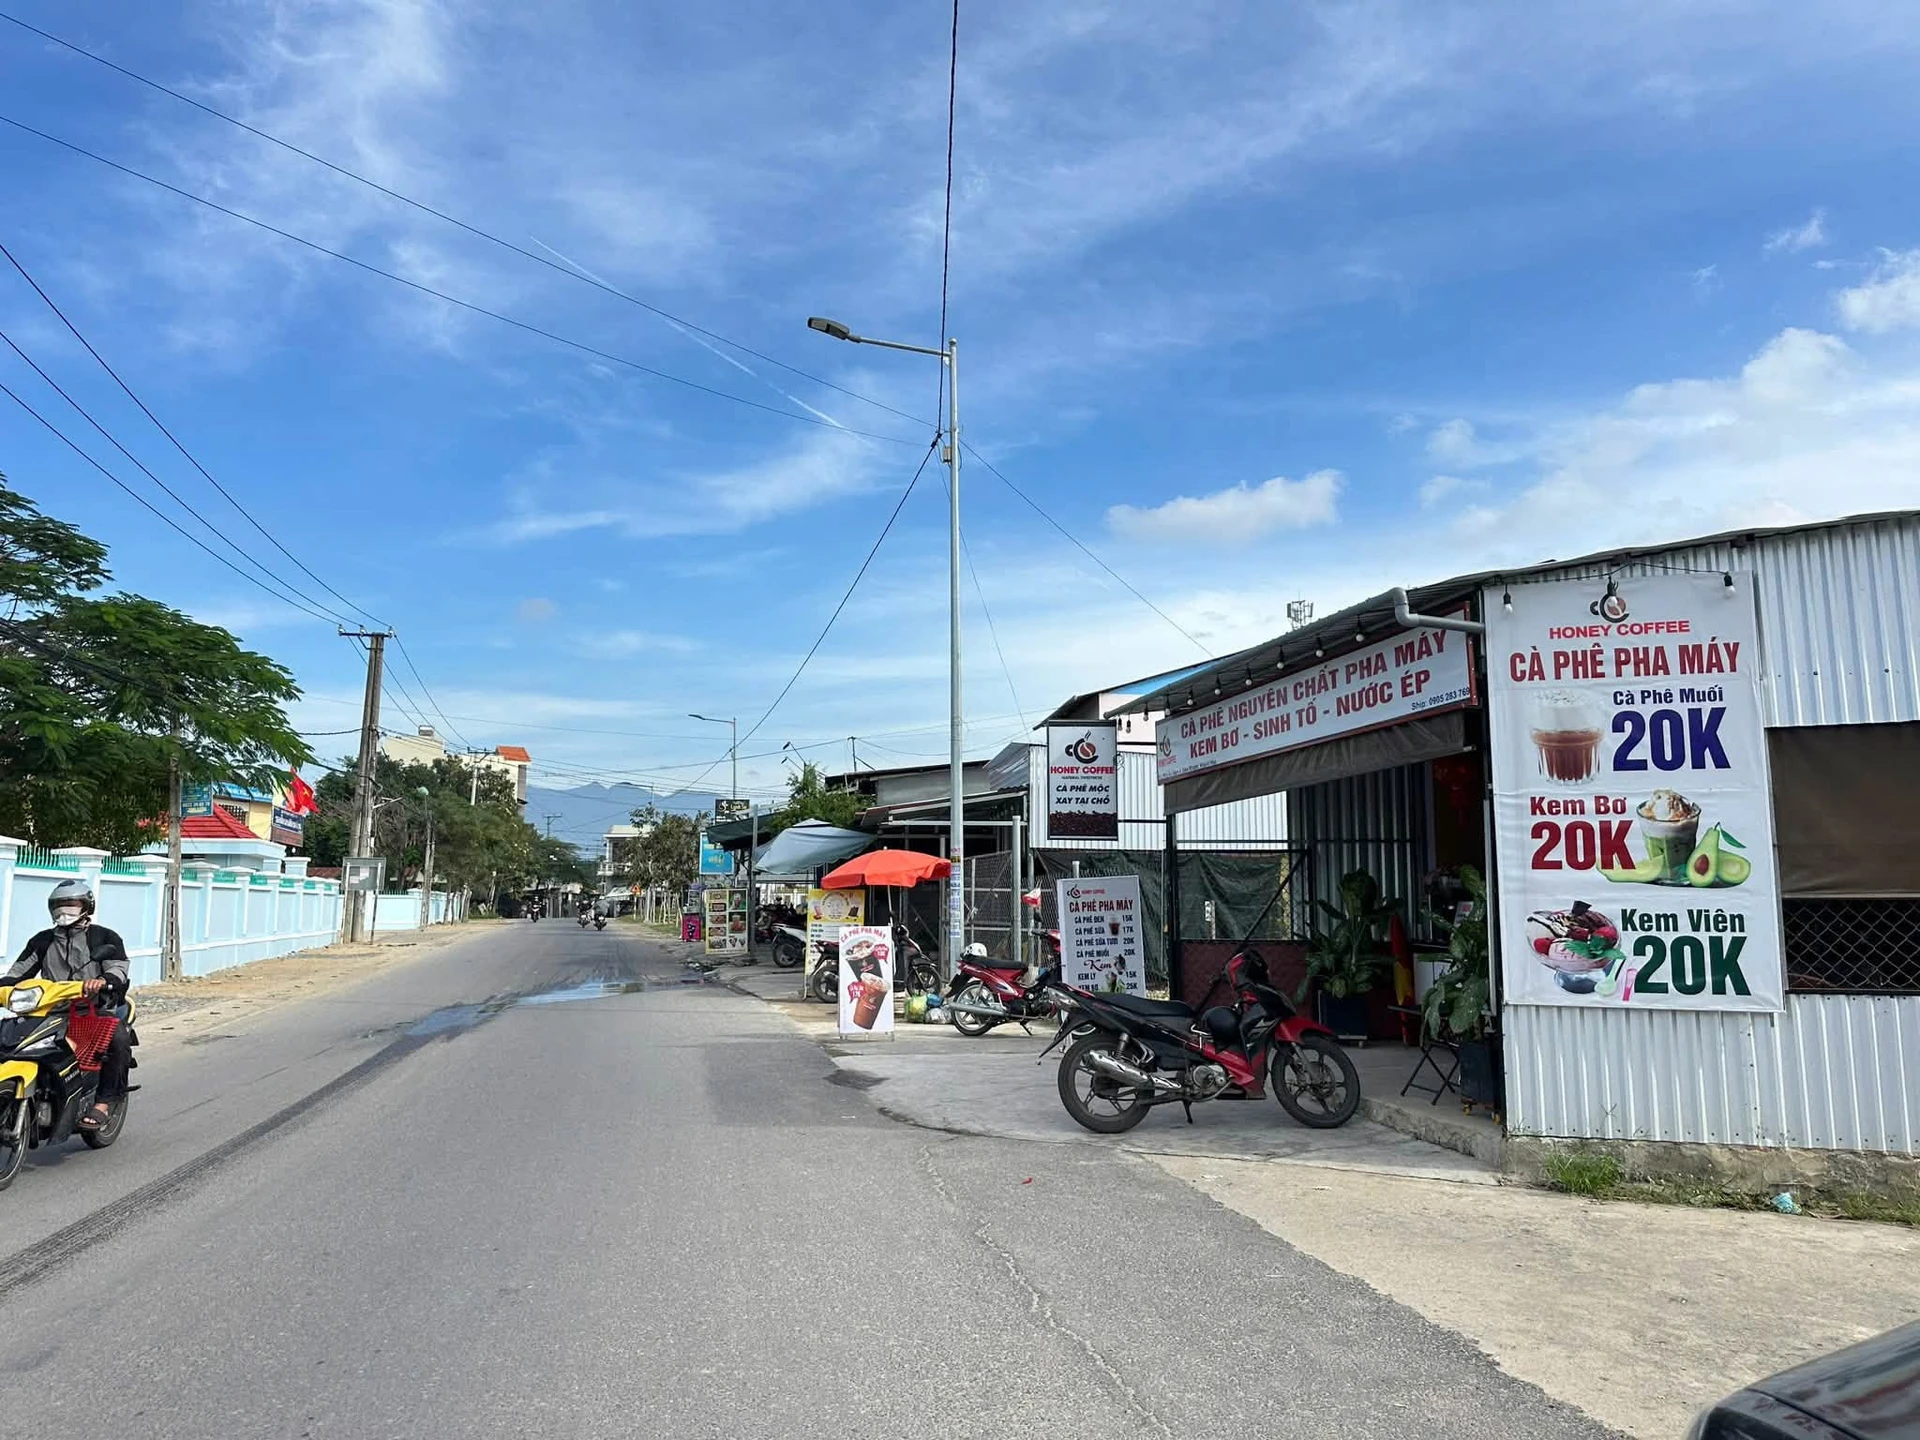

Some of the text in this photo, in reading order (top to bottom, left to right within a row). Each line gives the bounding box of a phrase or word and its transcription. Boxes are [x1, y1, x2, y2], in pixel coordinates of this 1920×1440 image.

[1550, 620, 1690, 639] HONEY COFFEE
[1510, 636, 1740, 682] CÀ PHÊ PHA MÁY
[1181, 630, 1446, 739] CÀ PHÊ NGUYÊN CHẤT PHA MÁY
[1614, 685, 1723, 706] Cà Phê Muối
[1191, 736, 1217, 758] KEM
[1221, 728, 1239, 749] BƠ
[1254, 713, 1291, 740] SINH
[1296, 698, 1317, 728] TỐ
[1336, 682, 1393, 717] NƯỚC
[1401, 669, 1430, 698] ÉP
[1611, 707, 1731, 772] 20K
[1051, 766, 1115, 774] HONEY COFFEE
[1056, 783, 1067, 792] CÀ
[1070, 783, 1088, 792] PHÊ
[1530, 796, 1627, 816] Kem Bơ
[1531, 820, 1636, 871] 20K
[1070, 898, 1133, 912] CÀ PHÊ PHA MÁY
[1621, 908, 1745, 932] Kem Viên
[1084, 959, 1112, 971] Kem
[1633, 936, 1752, 996] 20K
